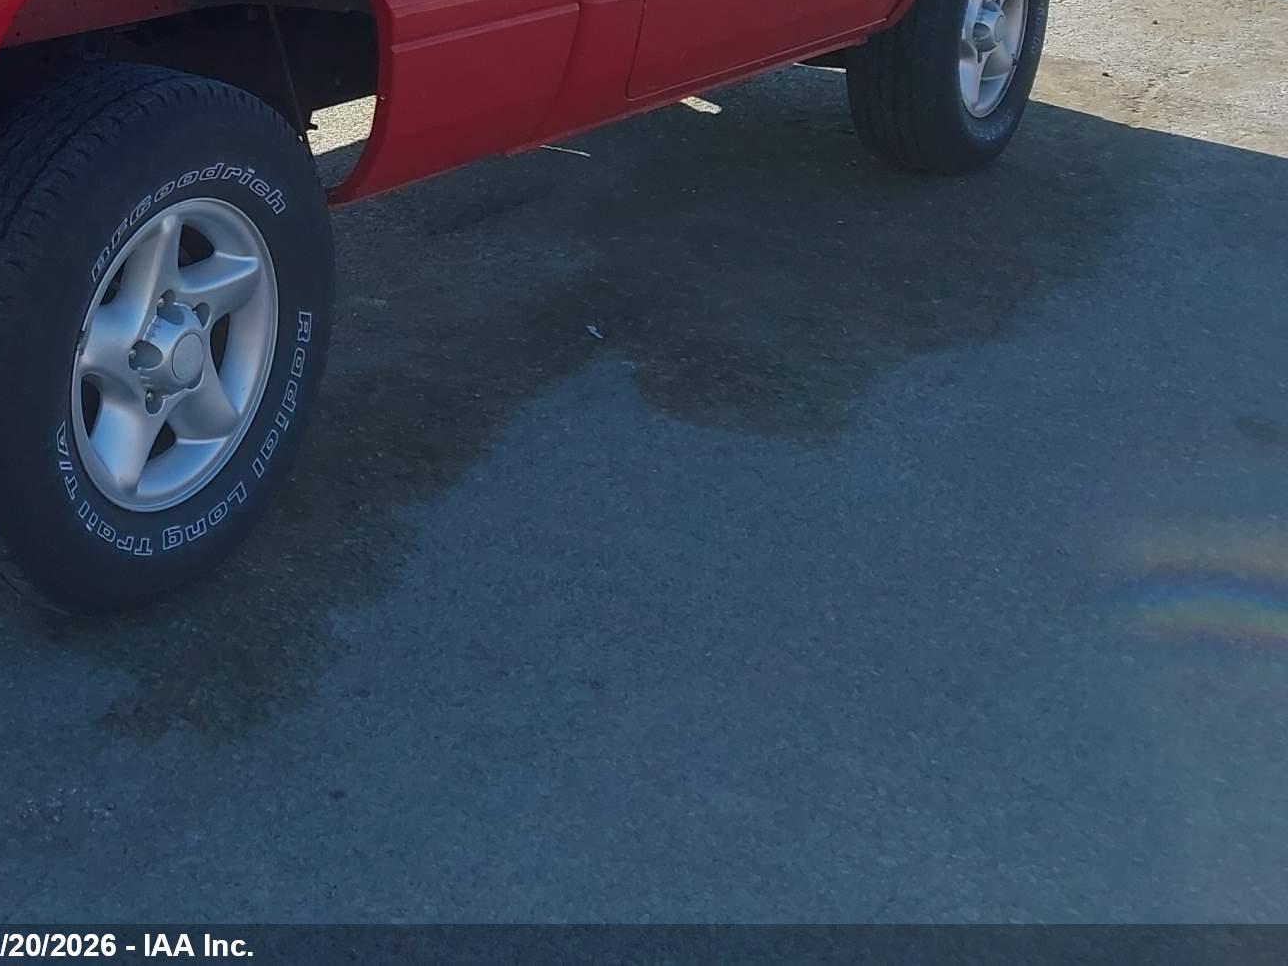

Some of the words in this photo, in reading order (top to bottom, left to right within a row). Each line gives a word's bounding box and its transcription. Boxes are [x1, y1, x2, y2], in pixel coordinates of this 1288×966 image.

[91, 162, 287, 282] BFGoodrich
[252, 310, 312, 479] Radial
[77, 500, 153, 556] Trail
[162, 481, 248, 551] Long
